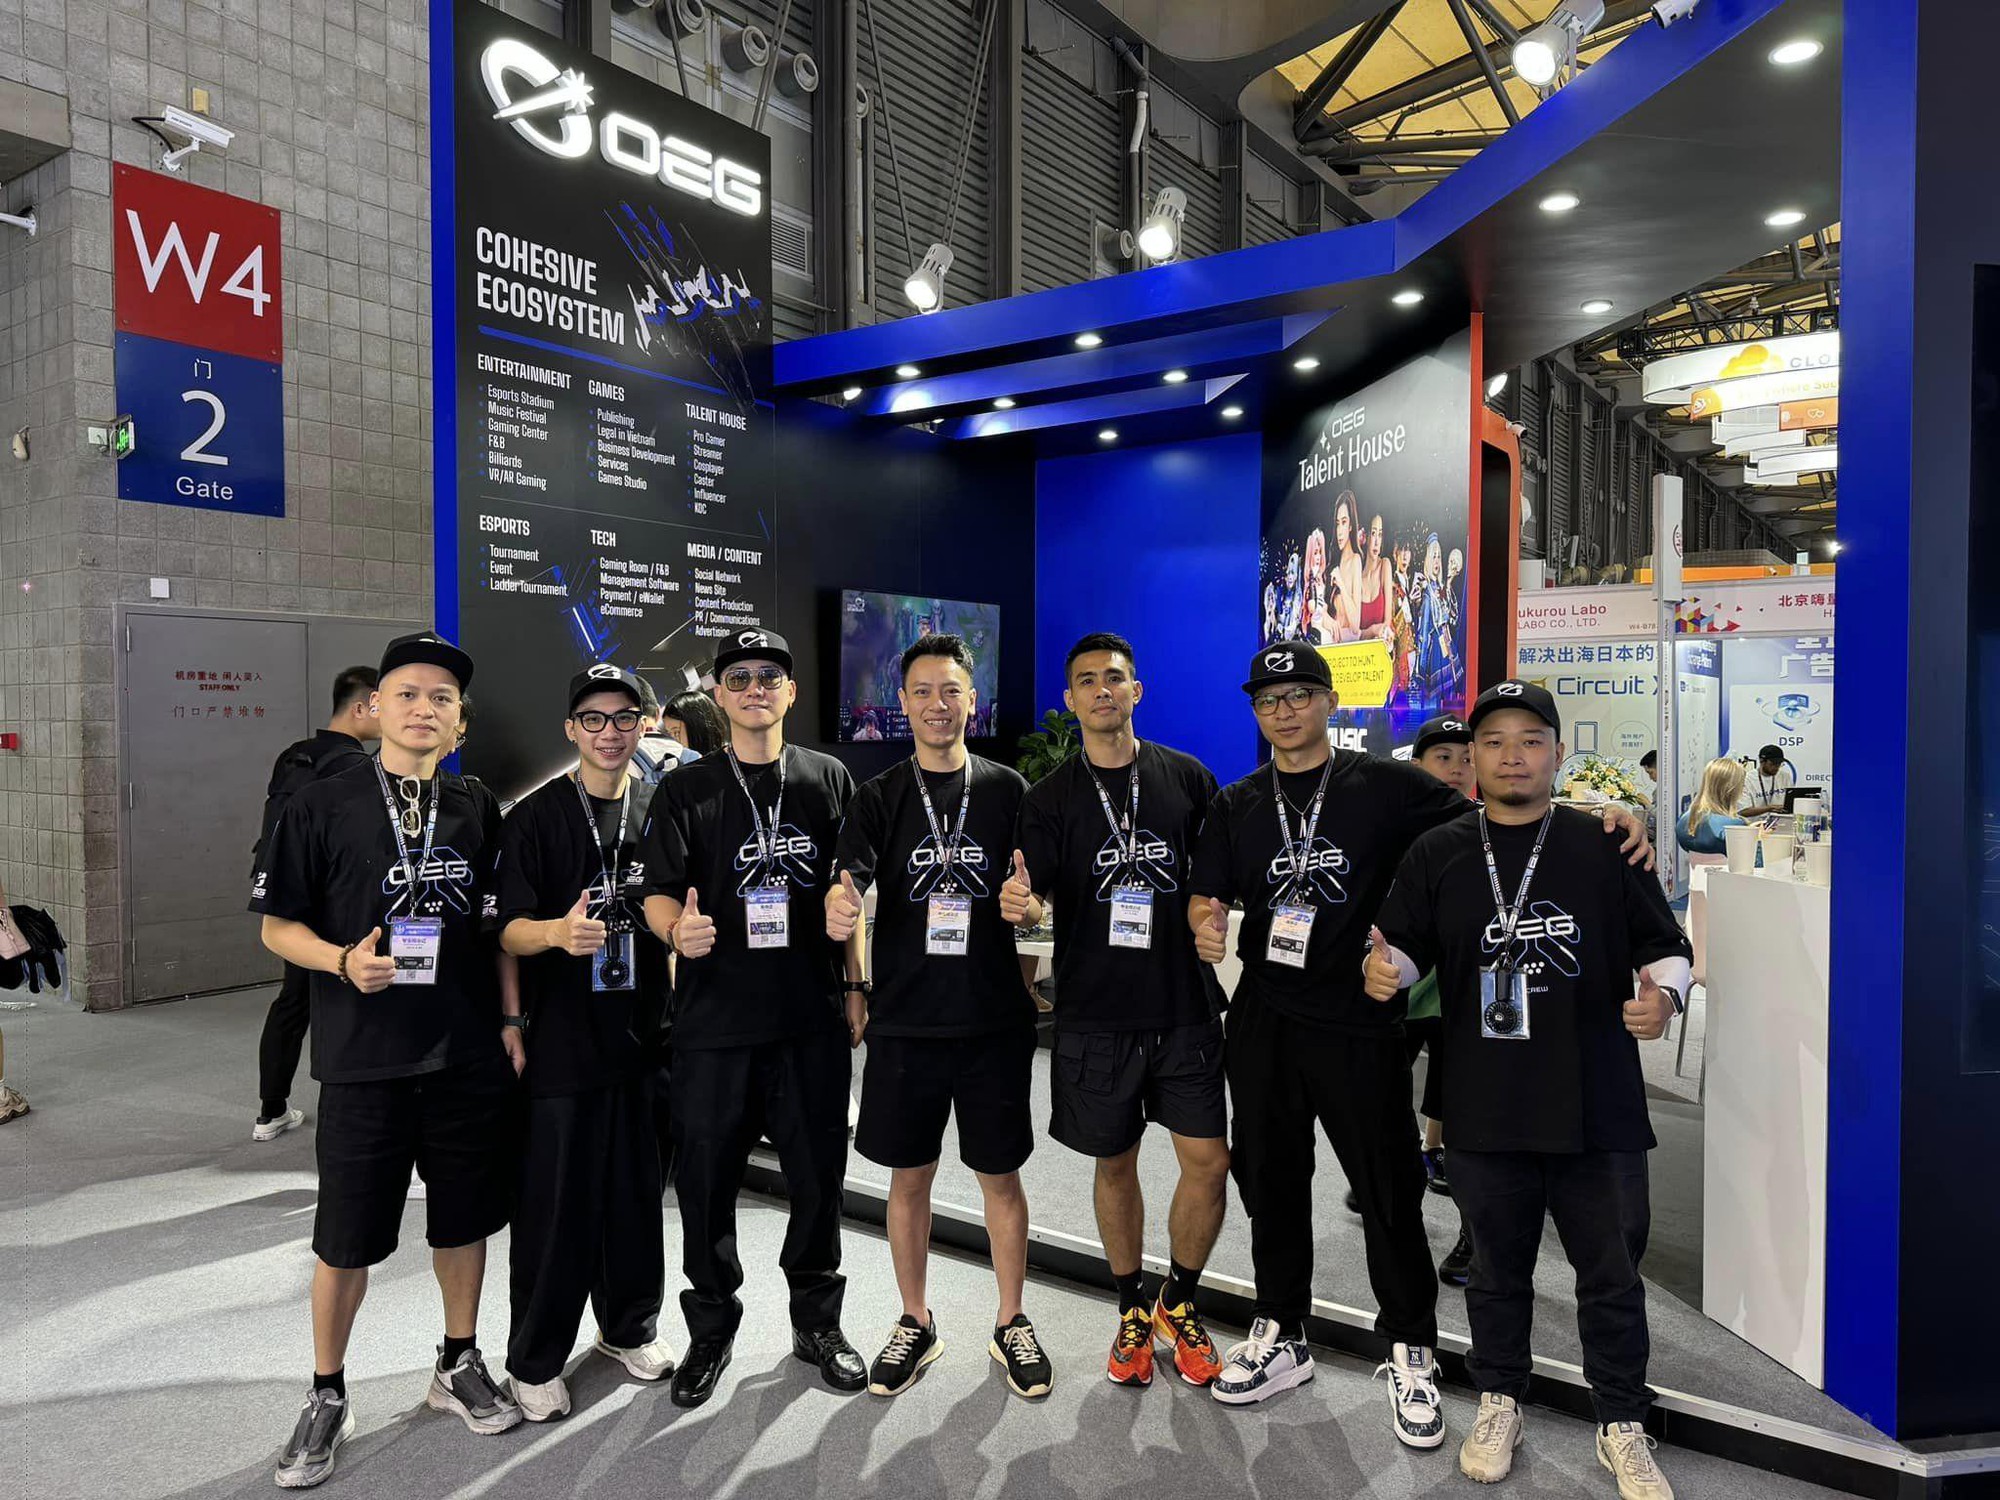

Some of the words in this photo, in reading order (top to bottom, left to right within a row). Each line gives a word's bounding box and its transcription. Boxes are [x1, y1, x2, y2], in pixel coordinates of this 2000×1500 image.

[600, 111, 762, 217] OEG
[126, 208, 271, 317] W4
[476, 226, 597, 295] COHESIVE
[477, 271, 625, 346] ECOSYSTEM
[194, 357, 212, 380] 门
[477, 353, 572, 389] ENTERTAINMENT
[488, 384, 520, 403] Esports
[521, 391, 555, 411] Stadium
[588, 379, 625, 402] GAMES
[488, 400, 514, 418] Music
[516, 406, 547, 425] Festival
[597, 407, 635, 430] Publishing
[685, 403, 717, 424] TALENT
[719, 410, 747, 431] HOUSE
[1331, 406, 1365, 438] OEG
[181, 389, 228, 466] 2
[488, 417, 520, 438] Gaming
[521, 424, 549, 441] Center
[597, 423, 616, 440] Legal
[618, 427, 626, 441] in
[627, 429, 656, 447] Vietnam
[693, 429, 704, 442] Pro
[705, 432, 726, 447] Gamer
[488, 434, 505, 449] F&B
[693, 444, 723, 460] Streamer
[488, 450, 522, 469] Billiards
[597, 439, 630, 456] Business
[631, 446, 676, 466] Development
[597, 454, 629, 472] Services
[1299, 444, 1344, 492] Talent
[1348, 424, 1406, 473] House
[693, 459, 724, 476] Cosplayer
[176, 476, 234, 501] Gate
[488, 467, 514, 485] VR/AR
[516, 471, 547, 491] Gaming
[598, 470, 623, 486] Games
[624, 475, 648, 491] Studio
[693, 473, 715, 487] Caster
[694, 487, 727, 504] Influencer
[479, 514, 531, 537] ESPORTS
[590, 529, 617, 548] TECH
[489, 543, 540, 562] Tournament
[687, 542, 716, 560] MEDIA
[724, 547, 763, 566] CONTENT
[490, 560, 514, 576] Event
[600, 556, 628, 574] Gaming
[629, 560, 649, 574] Room
[655, 563, 670, 577] F&B
[694, 567, 714, 581] Social
[714, 569, 742, 584] Network
[600, 572, 648, 589] Management
[648, 577, 680, 592] Software
[694, 582, 713, 595] News
[713, 584, 727, 596] Site
[600, 587, 632, 603] Payment
[639, 591, 665, 605] eWallet
[694, 596, 720, 610] Content
[721, 598, 754, 612] Production
[600, 603, 644, 618] eCommerce
[695, 610, 704, 622] PR
[709, 612, 760, 626] Communications
[1518, 607, 1566, 618] ukurou
[1571, 604, 1607, 616] Labo
[1576, 618, 1600, 628] LTD.
[1518, 644, 1654, 665] 解决出海日本的
[1557, 675, 1644, 696] Circuit
[1779, 737, 1804, 747] DSP
